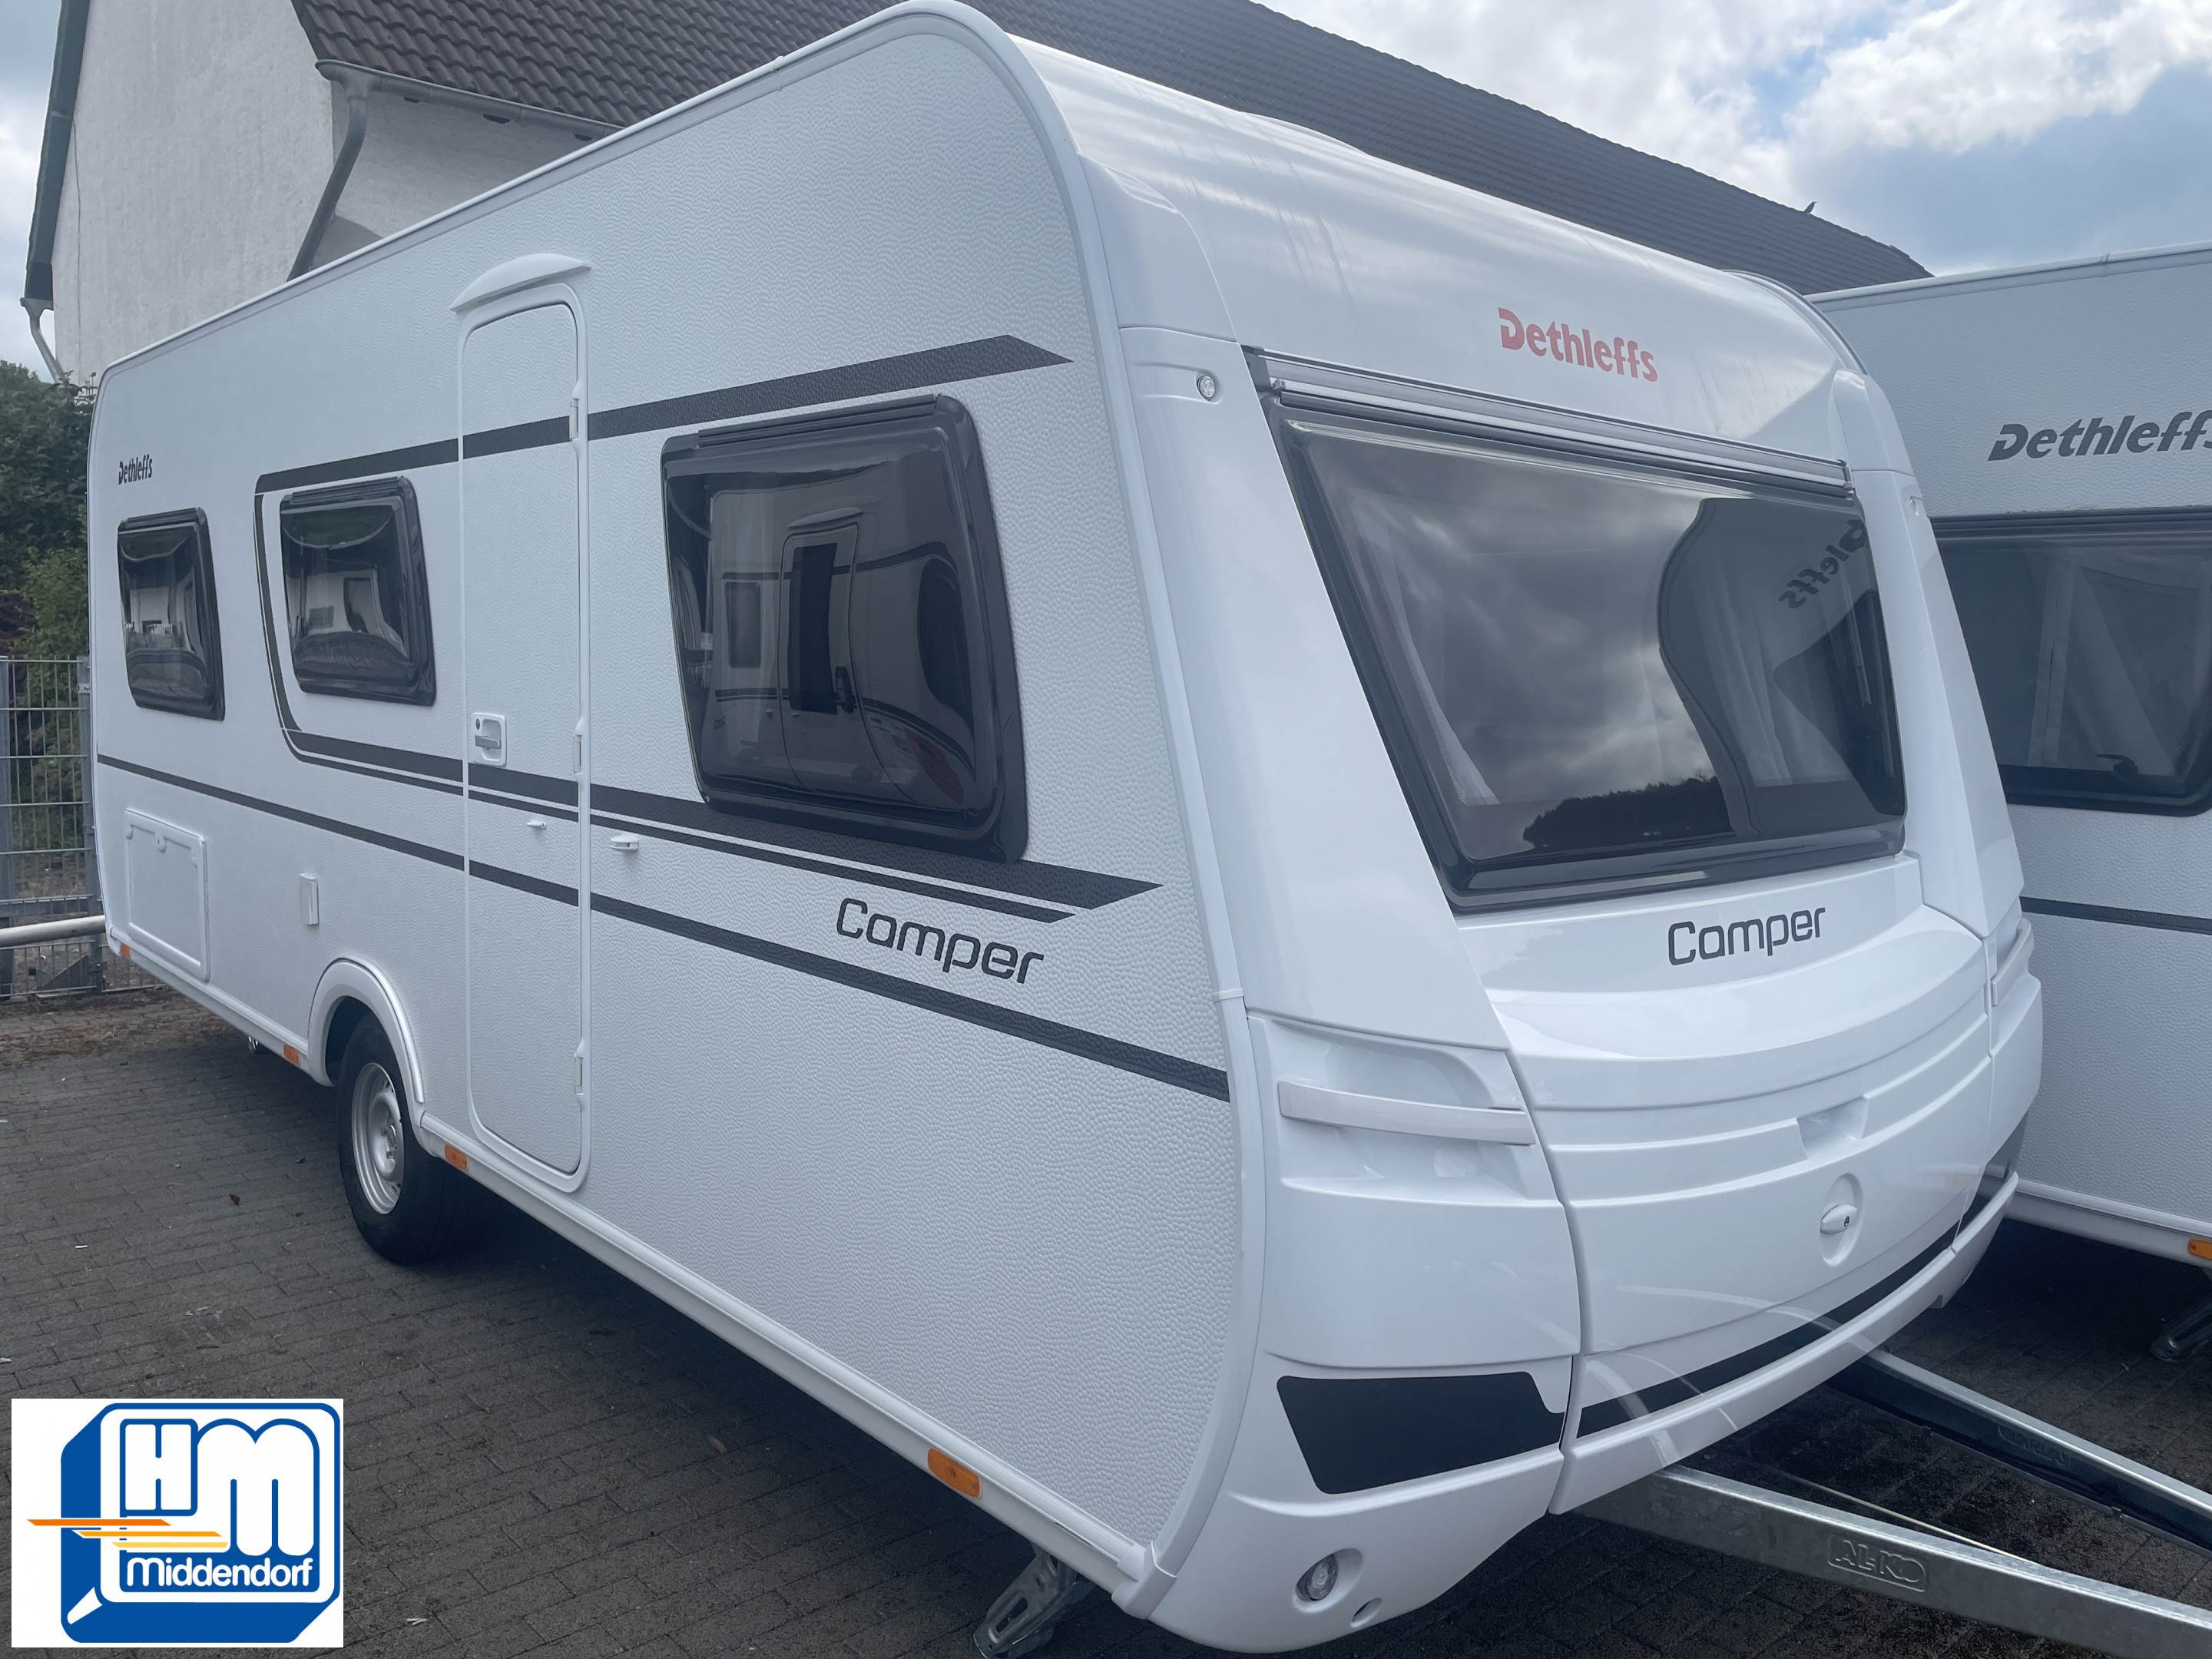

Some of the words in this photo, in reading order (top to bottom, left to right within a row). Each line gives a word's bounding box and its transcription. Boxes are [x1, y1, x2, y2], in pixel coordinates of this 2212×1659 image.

[1498, 306, 1658, 382] Dethleffs
[118, 453, 153, 485] Dethleffs
[836, 897, 1045, 984] Camper
[1667, 907, 1826, 965] Camper
